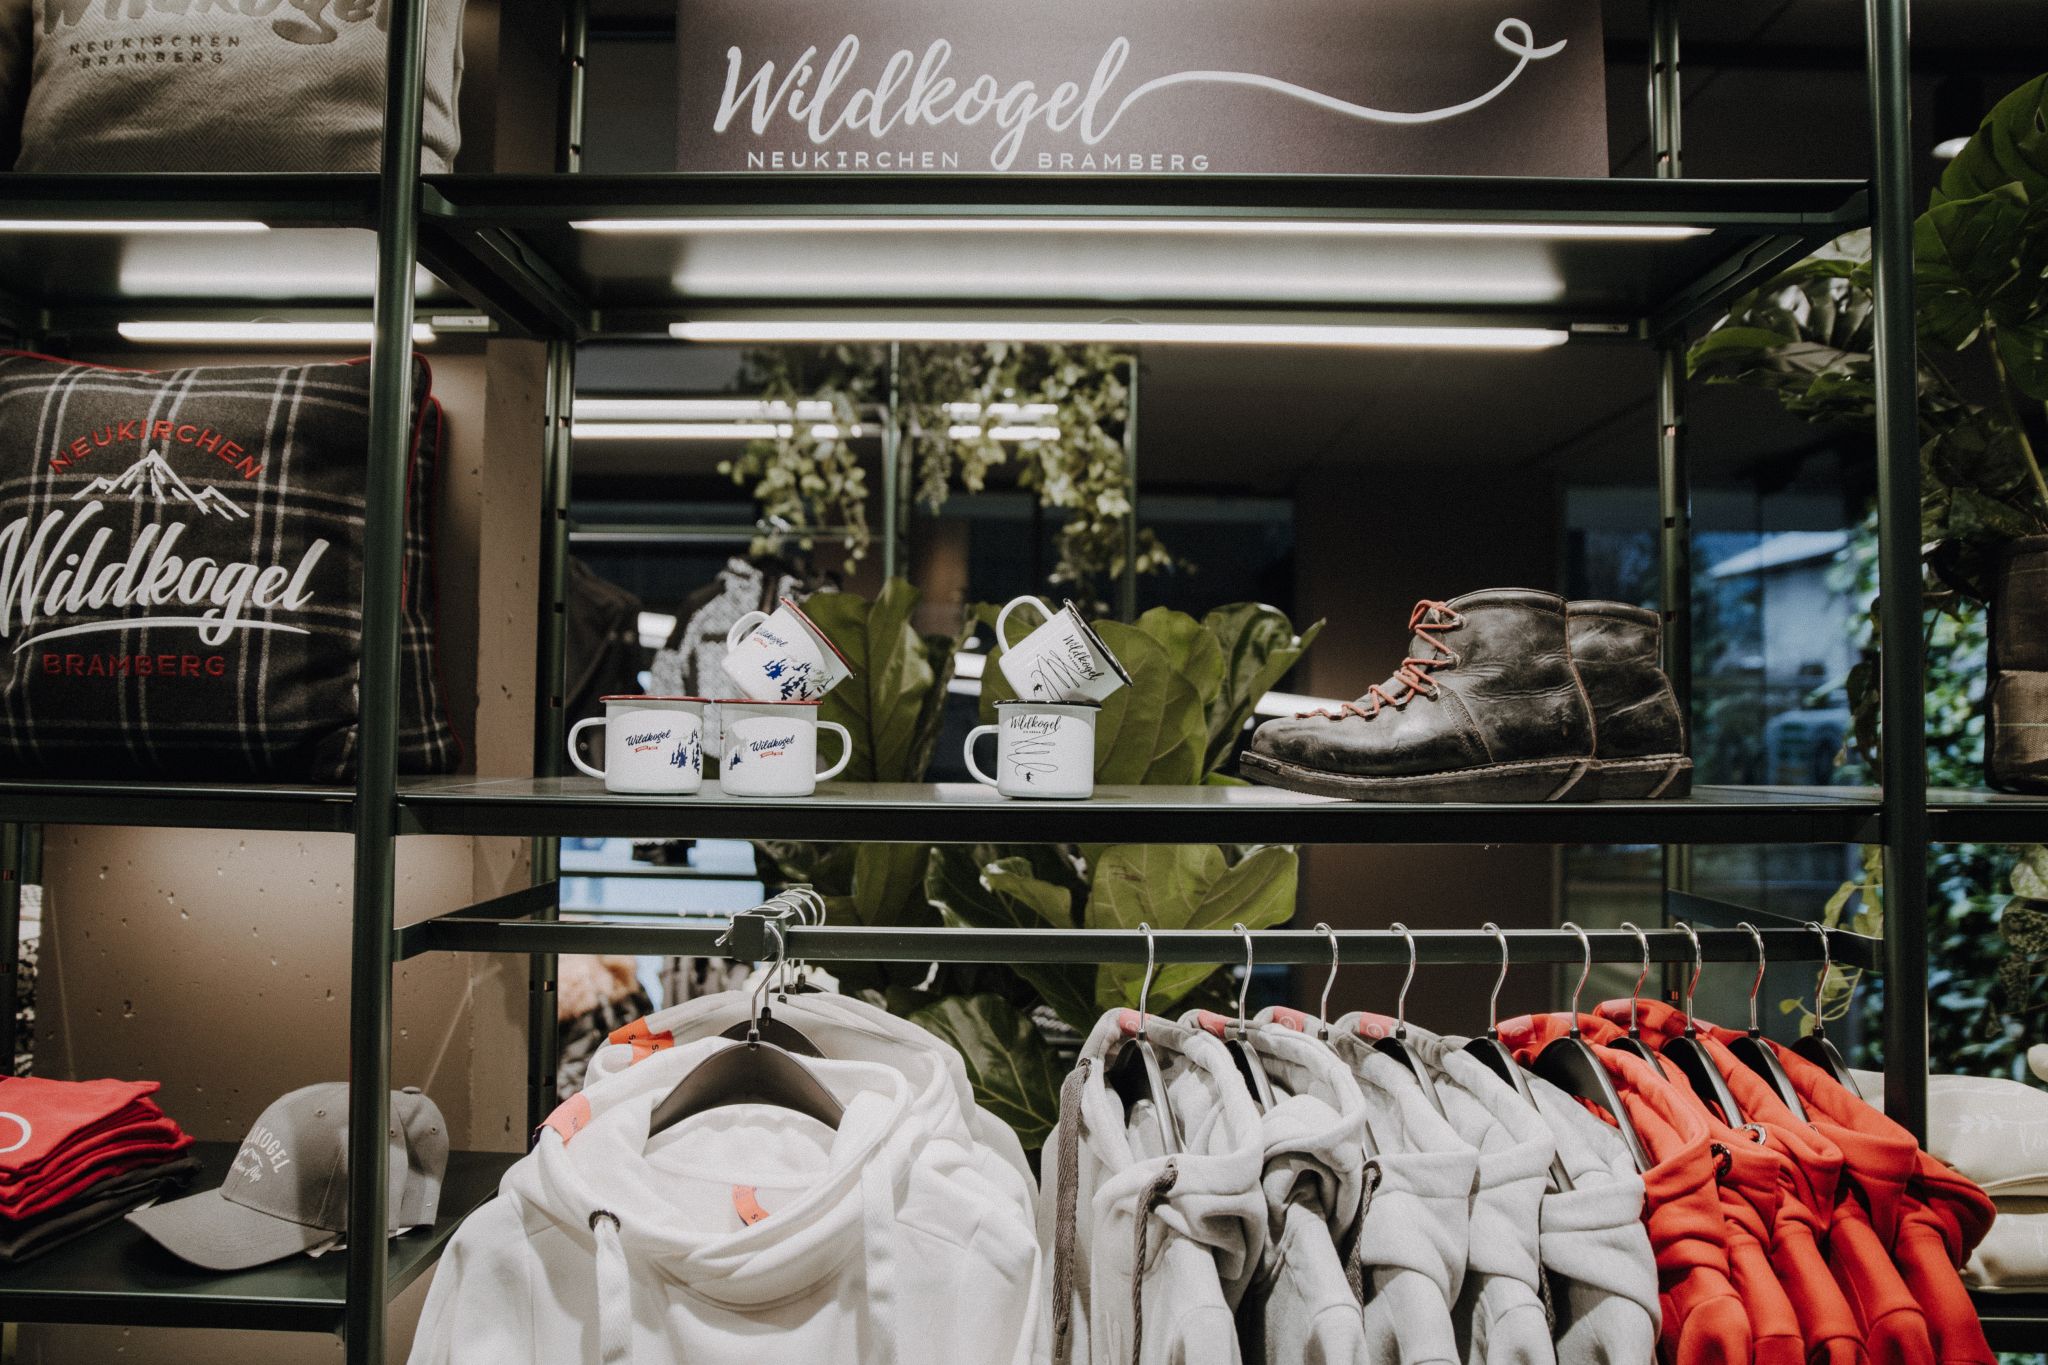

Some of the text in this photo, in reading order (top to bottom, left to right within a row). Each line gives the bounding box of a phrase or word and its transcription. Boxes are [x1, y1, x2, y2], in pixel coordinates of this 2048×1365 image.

[68, 34, 241, 56] NEUKIRCHEN
[81, 51, 224, 69] BRAMBERG
[713, 34, 1130, 171] Wildkogel
[747, 151, 1210, 171] NEUKIRCHEN BRAMBERG
[49, 419, 264, 481] NEUKIRCHEN
[0, 500, 330, 646] Wildkogel
[43, 653, 226, 678] BRAMBERG
[1010, 714, 1062, 735] Wildkogel
[625, 729, 672, 747] Wildkogel
[749, 734, 795, 752] Wildkogel
